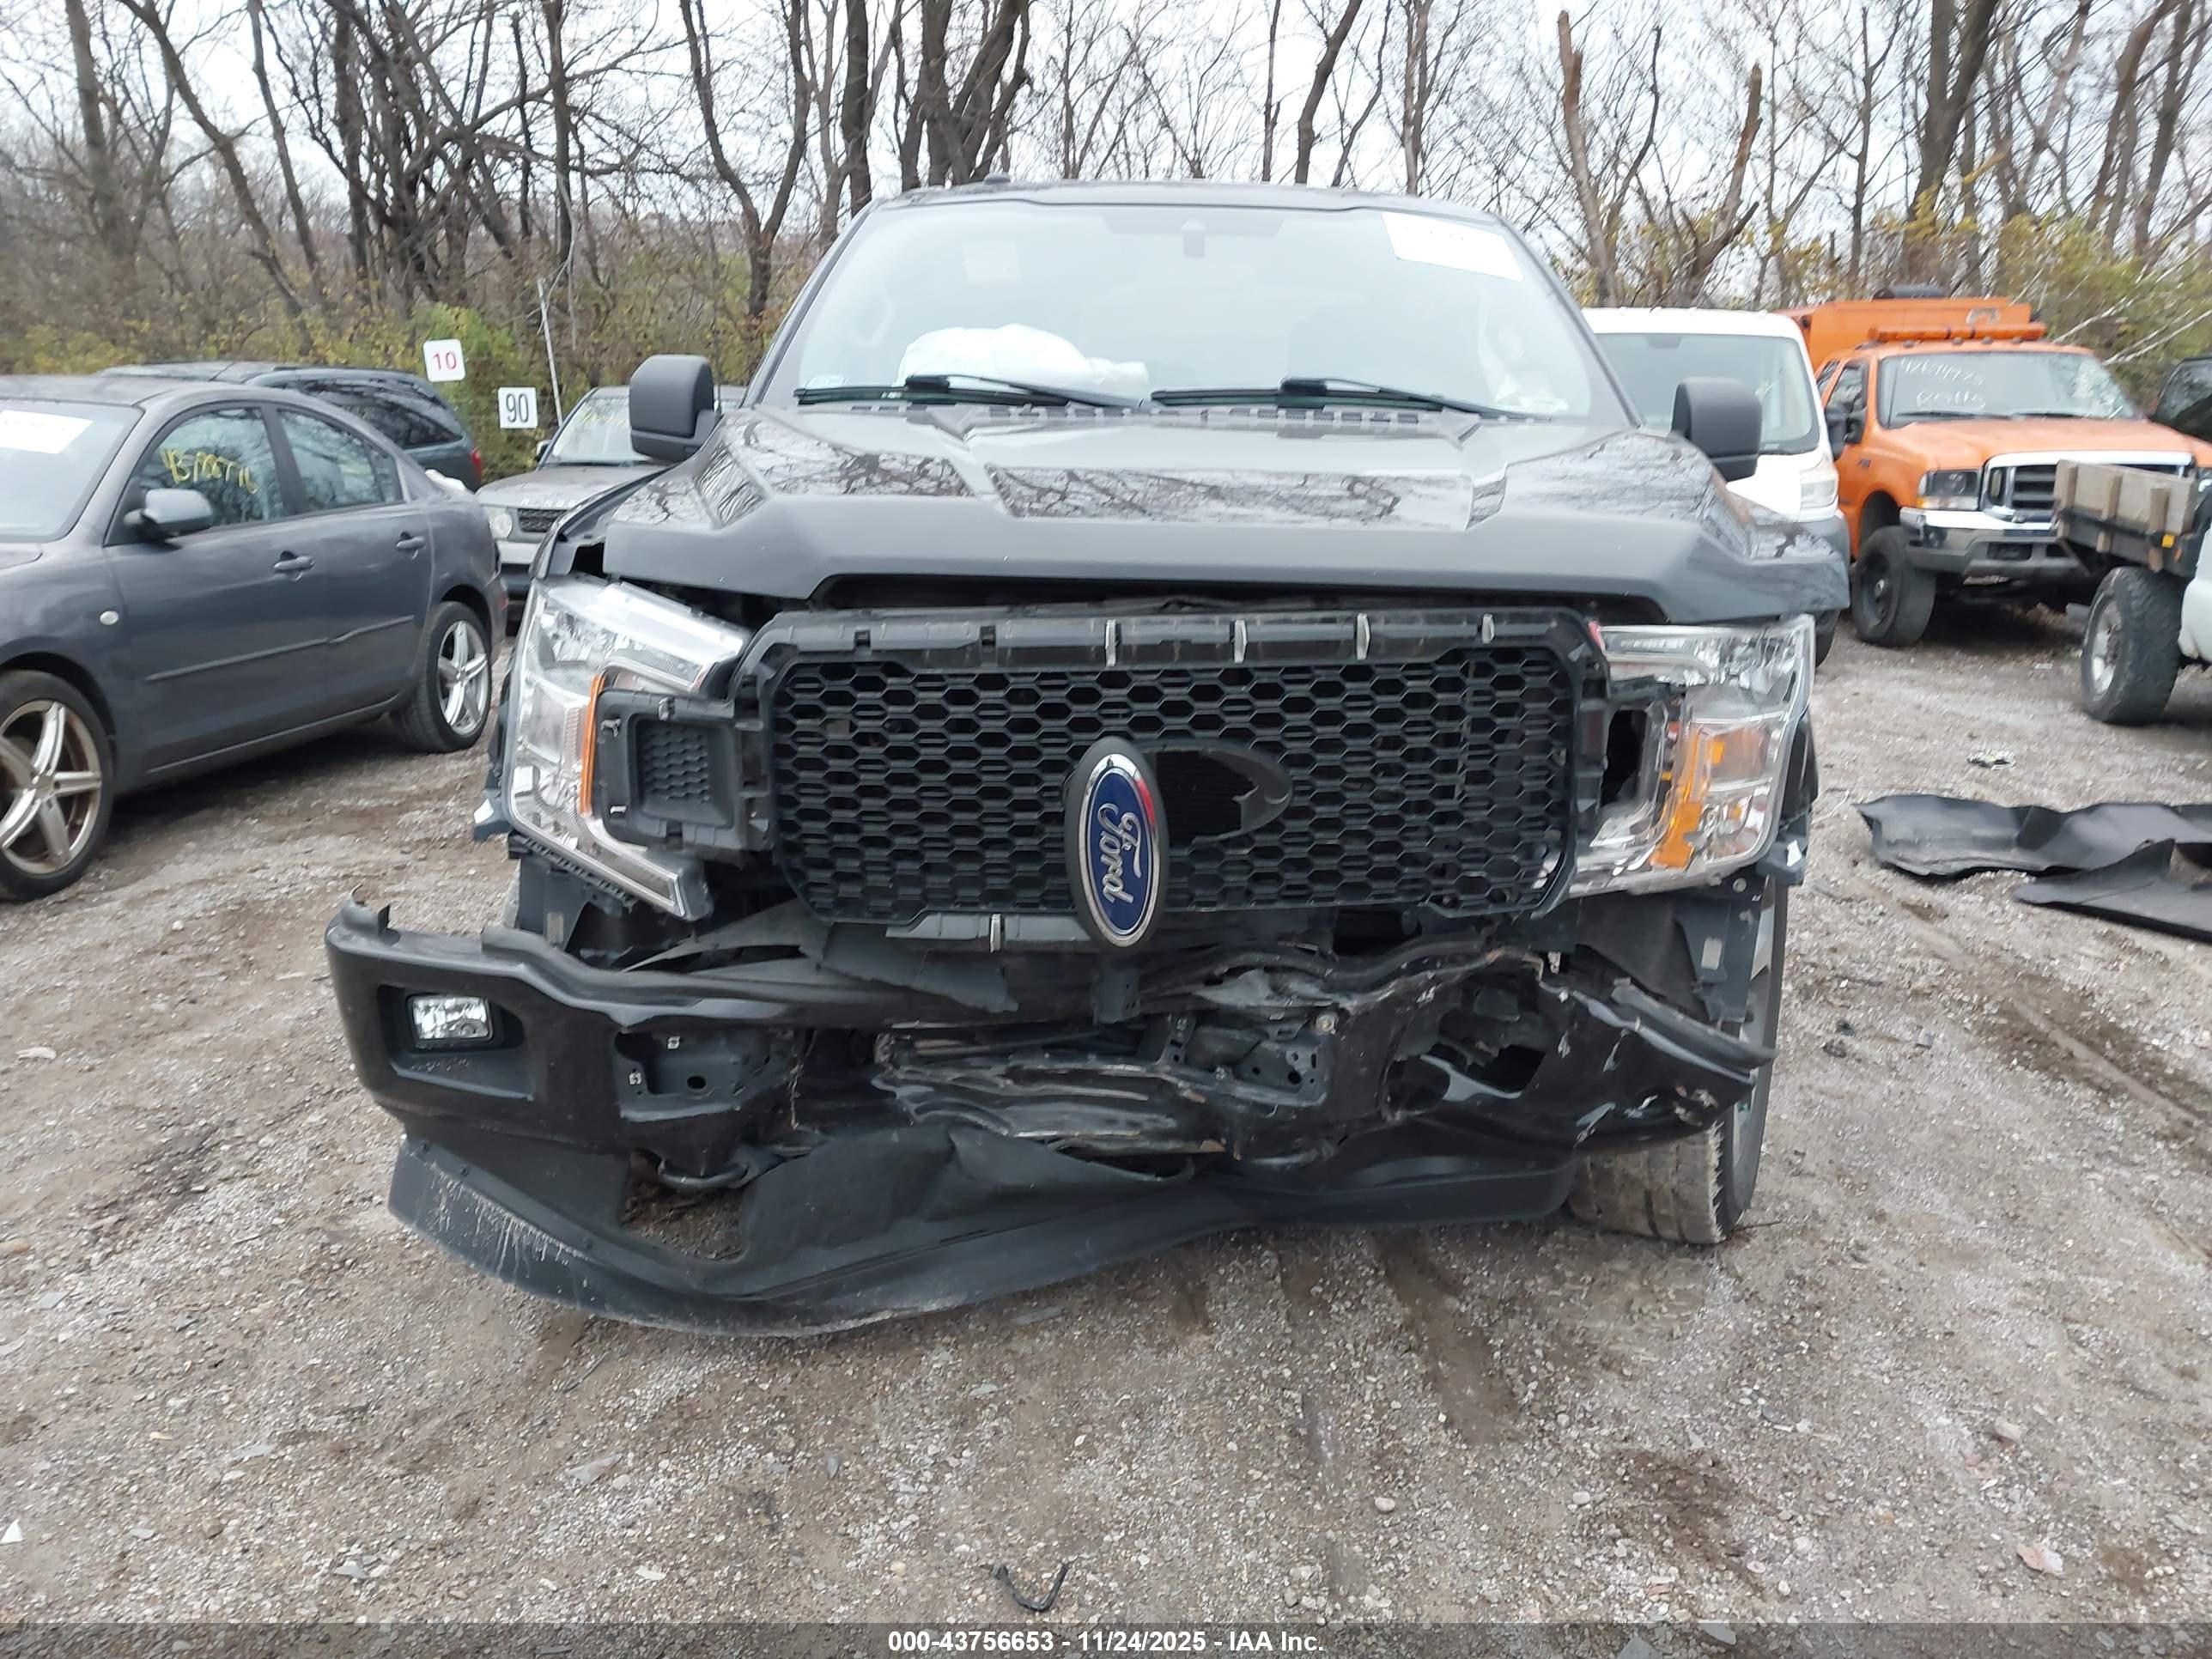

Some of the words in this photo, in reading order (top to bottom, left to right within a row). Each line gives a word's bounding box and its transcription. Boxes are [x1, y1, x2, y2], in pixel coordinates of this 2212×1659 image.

[433, 351, 458, 371] 10
[505, 392, 529, 423] 90
[1097, 802, 1142, 903] Ford
